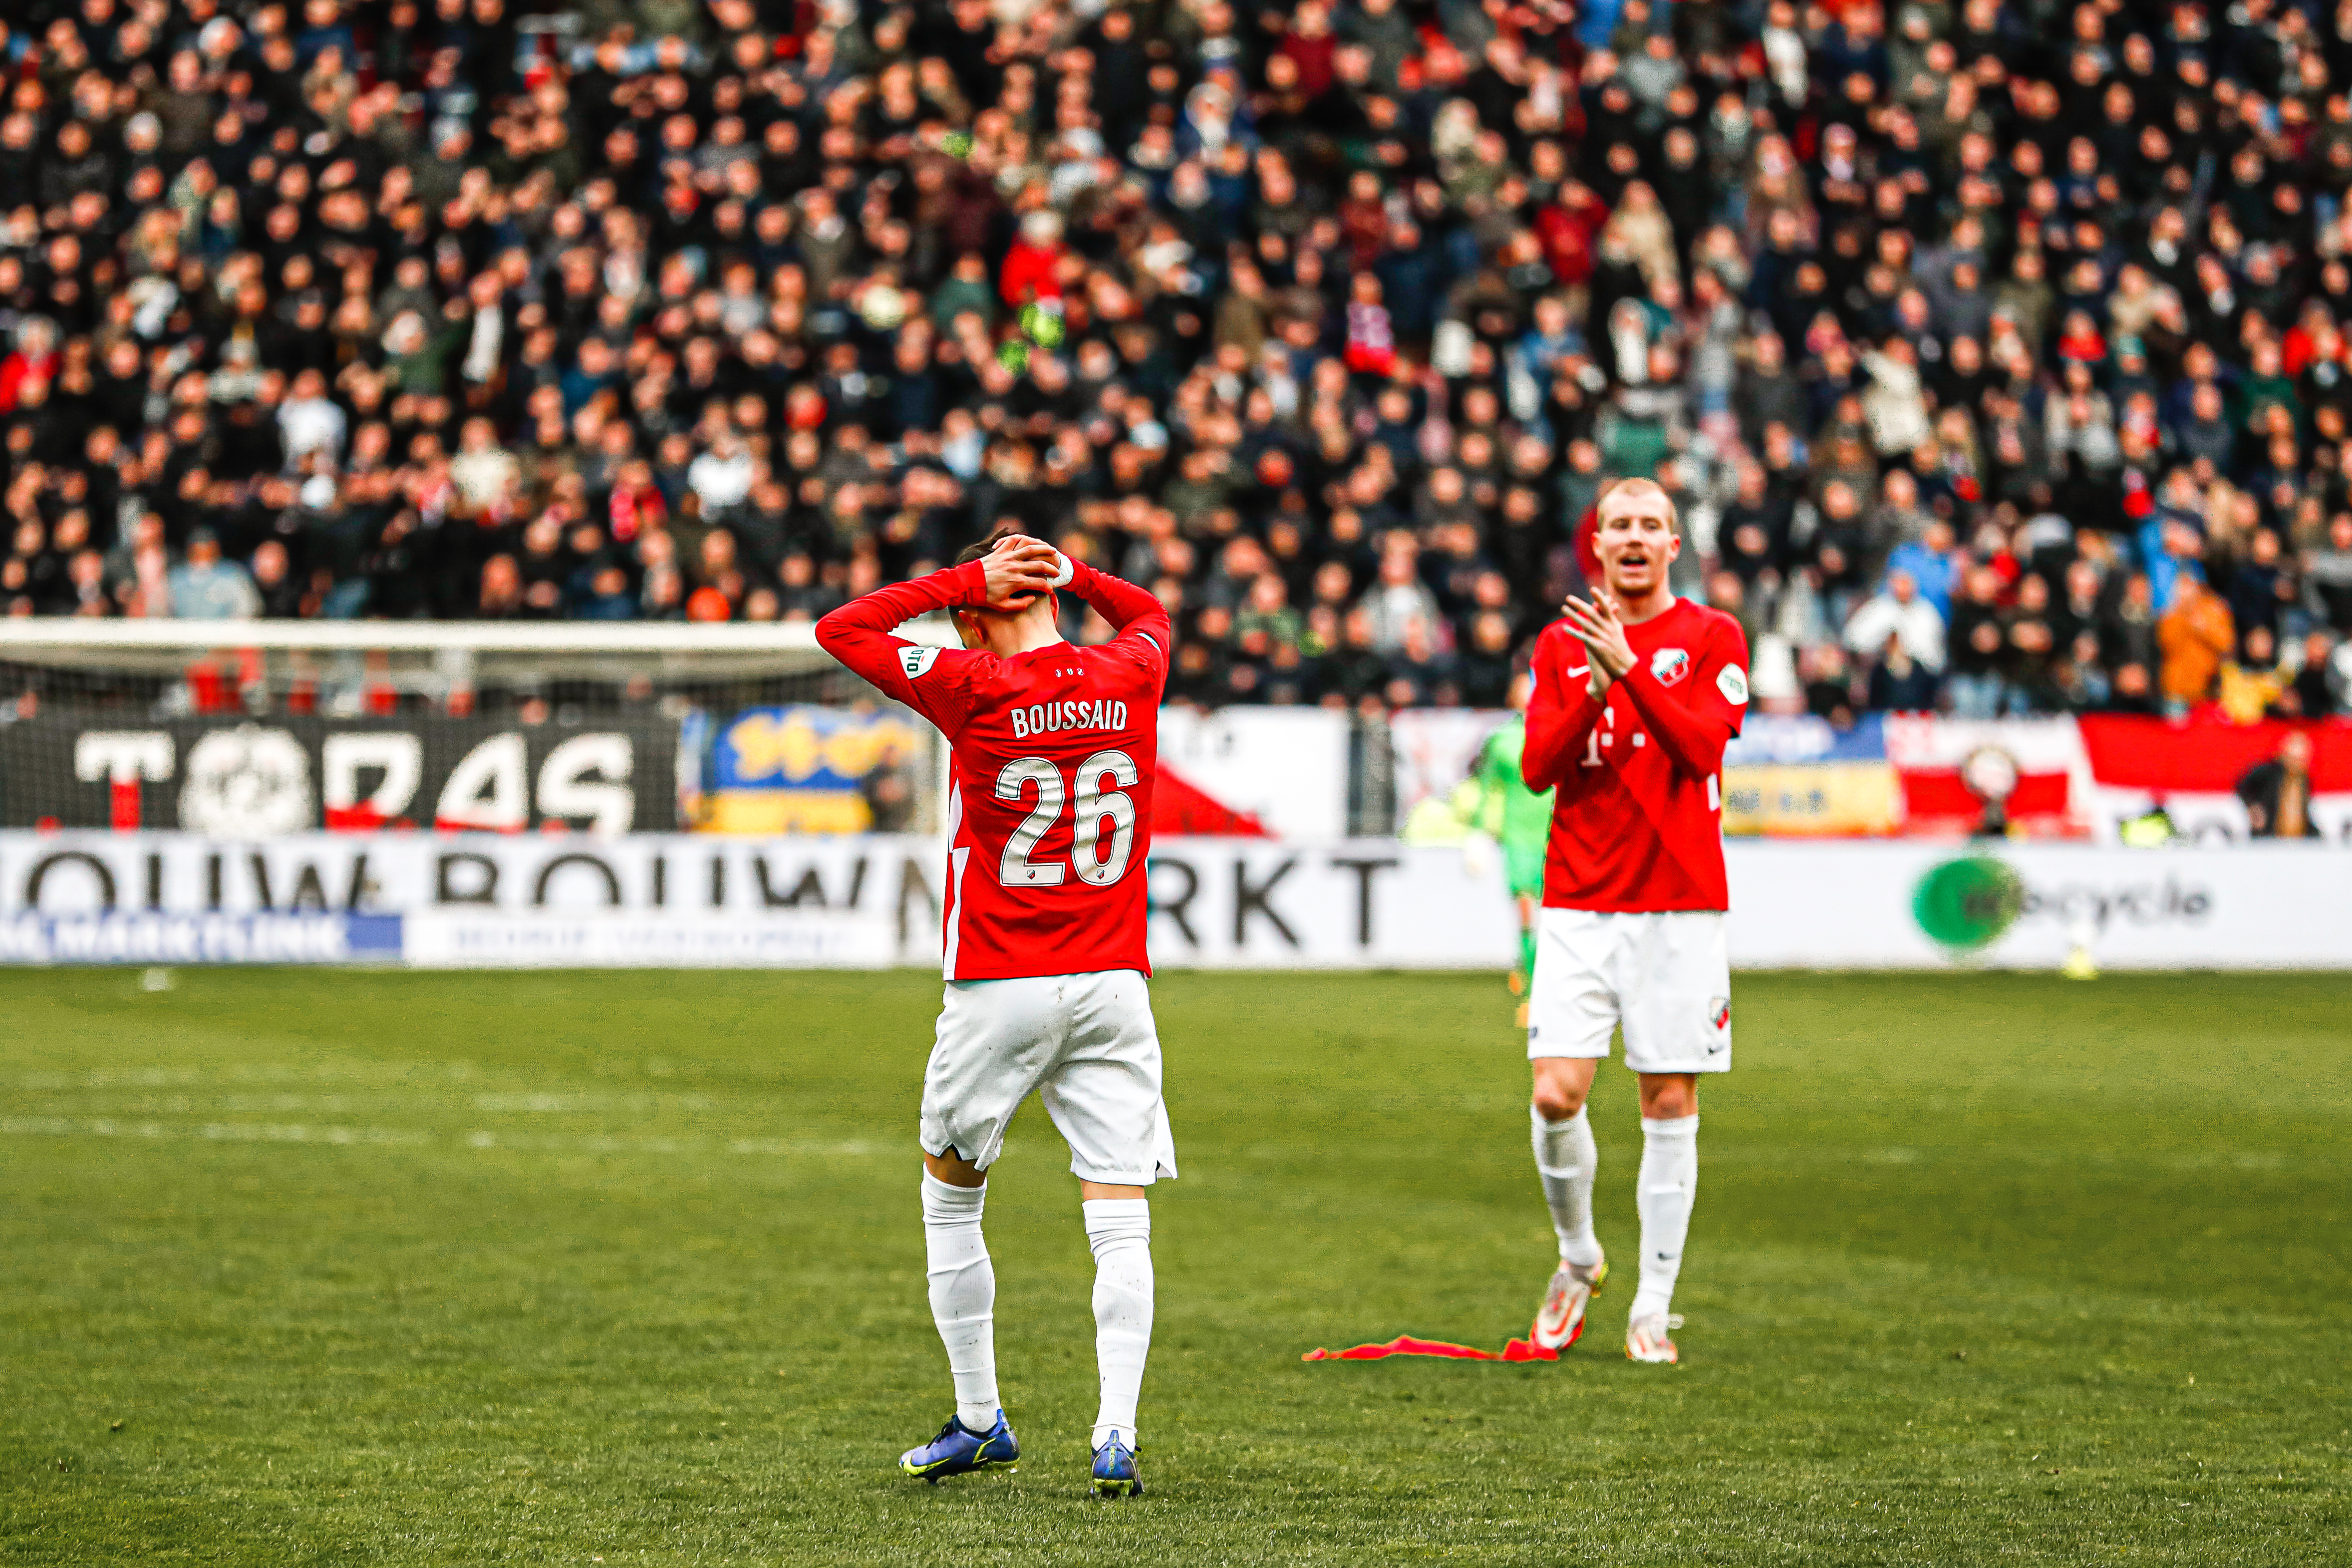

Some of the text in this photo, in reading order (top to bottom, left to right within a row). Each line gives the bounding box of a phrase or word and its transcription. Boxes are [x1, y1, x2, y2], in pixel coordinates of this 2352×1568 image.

[906, 647, 924, 672] OTO
[1011, 699, 1127, 738] BOUSSAID
[995, 749, 1139, 887] 26
